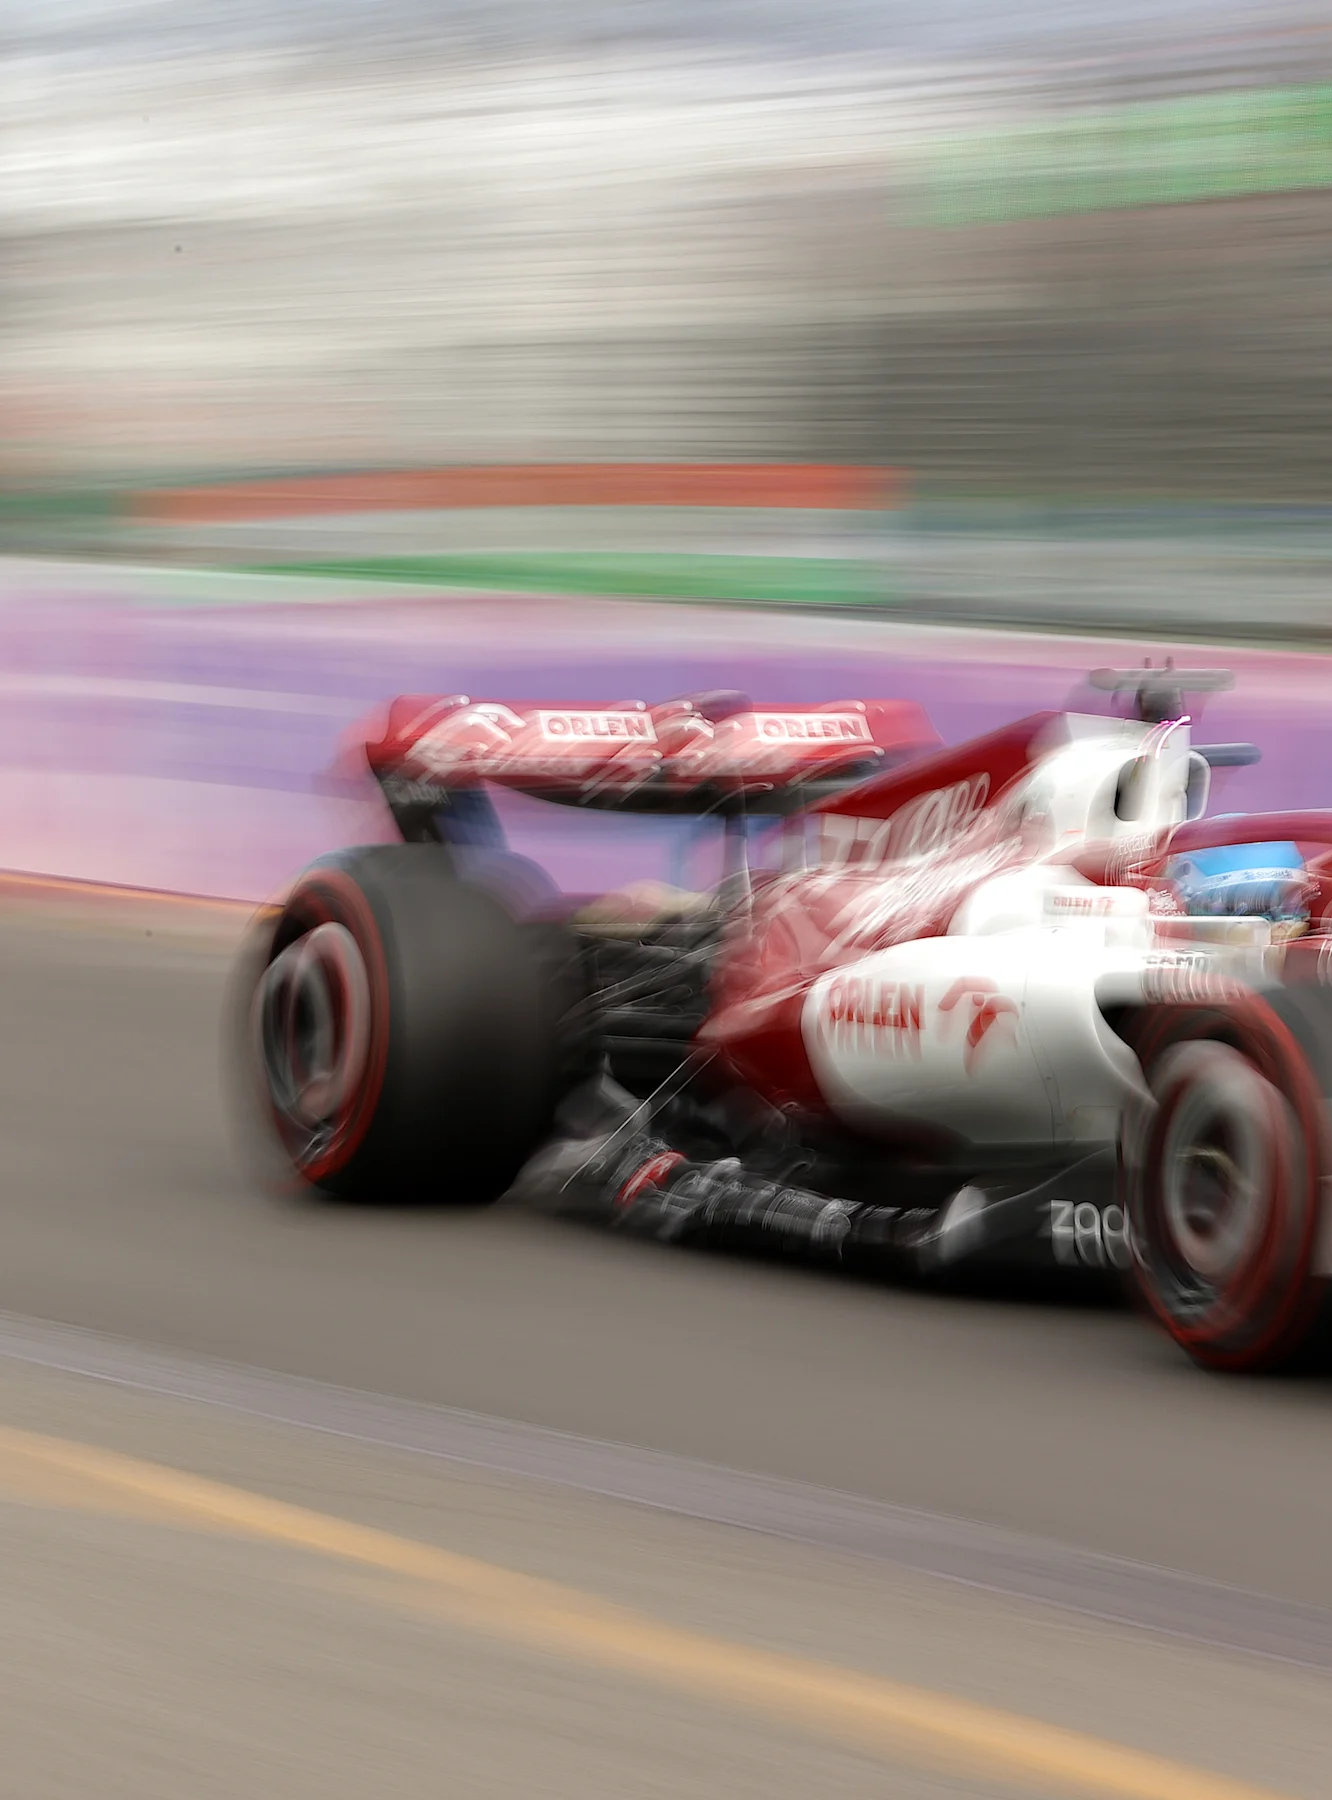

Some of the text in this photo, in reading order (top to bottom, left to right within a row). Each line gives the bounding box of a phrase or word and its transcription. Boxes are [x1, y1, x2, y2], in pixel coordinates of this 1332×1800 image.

[547, 716, 645, 737] ORLEN
[763, 718, 863, 739] ORLEN
[1053, 896, 1092, 907] ORLEN
[829, 975, 926, 1029] ORLEN
